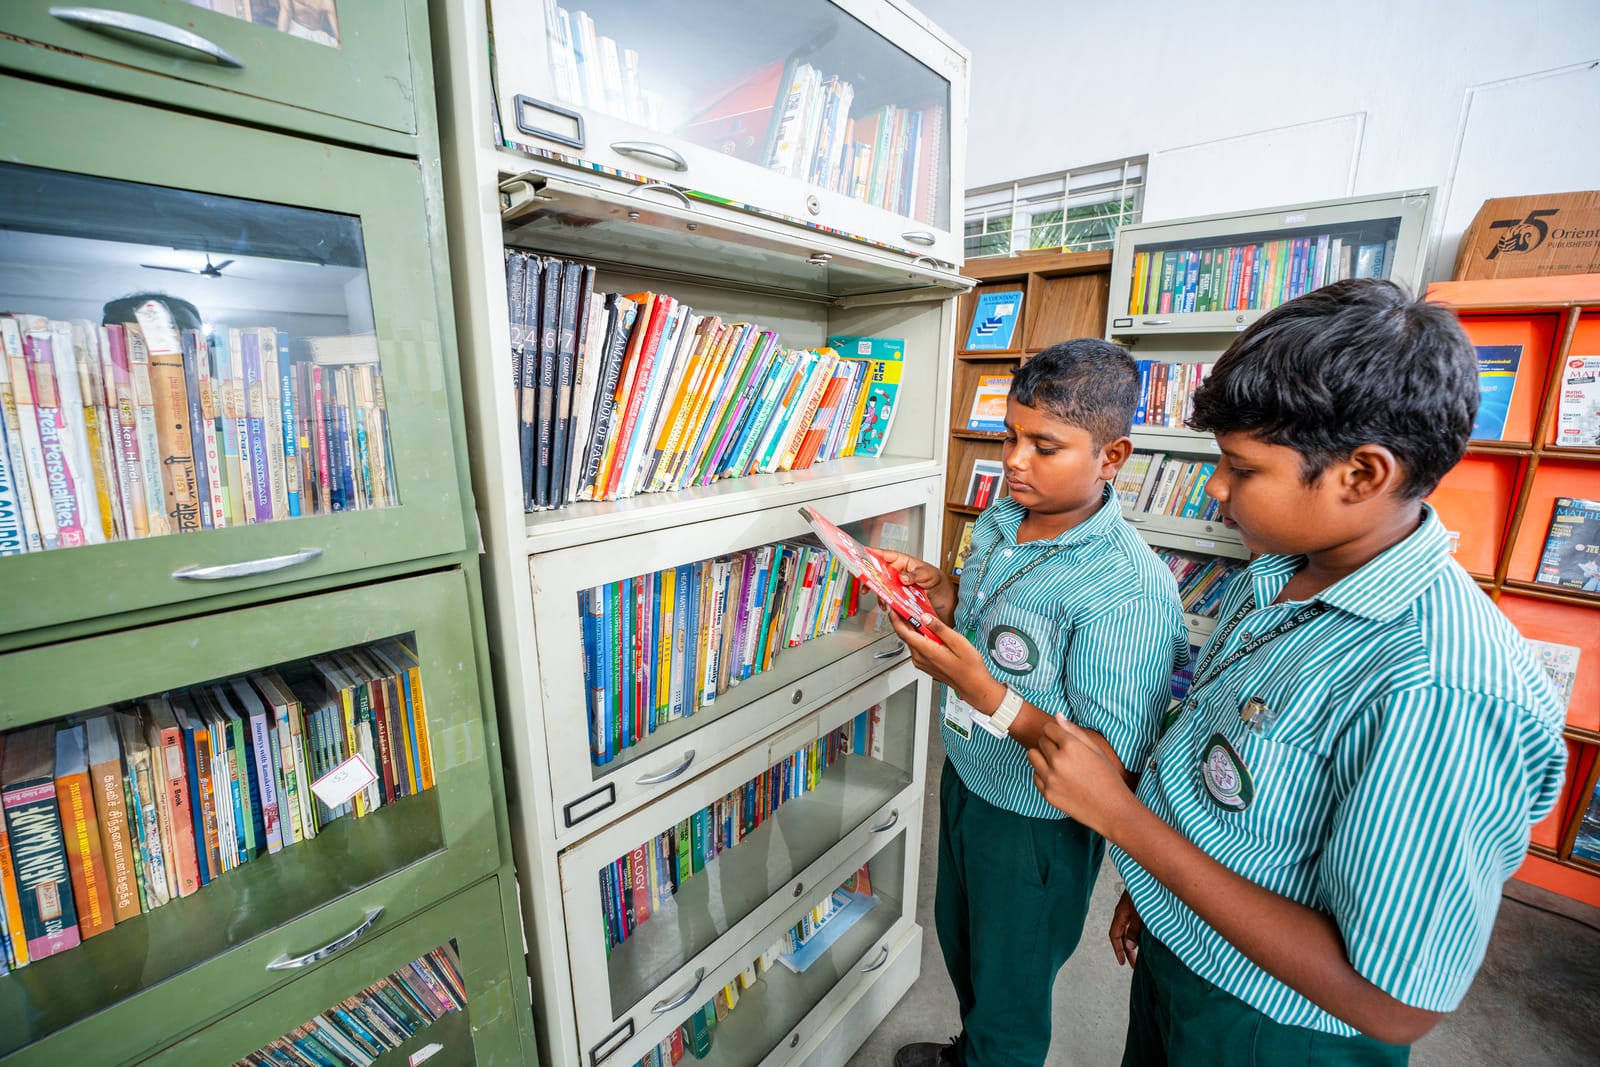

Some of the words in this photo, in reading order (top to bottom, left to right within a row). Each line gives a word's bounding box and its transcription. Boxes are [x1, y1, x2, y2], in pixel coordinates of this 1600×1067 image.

[1551, 227, 1600, 240] Orient
[510, 326, 523, 344] 2
[524, 330, 536, 346] 4
[544, 332, 554, 349] 6
[563, 333, 574, 349] 7
[511, 352, 522, 383] ANIMALS
[543, 356, 552, 386] ECOLOGY
[605, 334, 626, 390] AMAZING
[644, 353, 654, 369] Fun
[281, 375, 292, 407] English
[639, 370, 650, 387] with
[872, 374, 884, 382] ES
[598, 392, 612, 423] BOOK
[631, 388, 644, 417] Science
[120, 424, 135, 448] ken
[283, 408, 296, 443] Through
[541, 418, 549, 444] NMENT
[595, 425, 606, 440] OF
[787, 390, 823, 455] ENCYCLOPAEDIA
[124, 449, 142, 484] Hindi
[251, 437, 268, 506] GRAMMAR
[588, 442, 603, 477] FACTS
[44, 440, 73, 528] Personalities
[996, 573, 1022, 596] NATIONAL
[1192, 656, 1212, 684] KONGU
[1211, 620, 1238, 656] NATIONAL
[1238, 597, 1256, 620] MATR
[1211, 651, 1245, 675] NATIONAL
[1246, 631, 1279, 652] MATRIC.
[1280, 620, 1297, 633] HR.
[1298, 606, 1322, 623] SEC.
[359, 695, 369, 712] THE
[252, 721, 266, 748] Journeys
[258, 749, 268, 763] with
[172, 788, 182, 806] Book
[259, 763, 275, 802] Ramakrishna
[7, 802, 62, 857] KAMPF
[16, 849, 67, 891] MEIN
[630, 848, 648, 890] OLOGY
